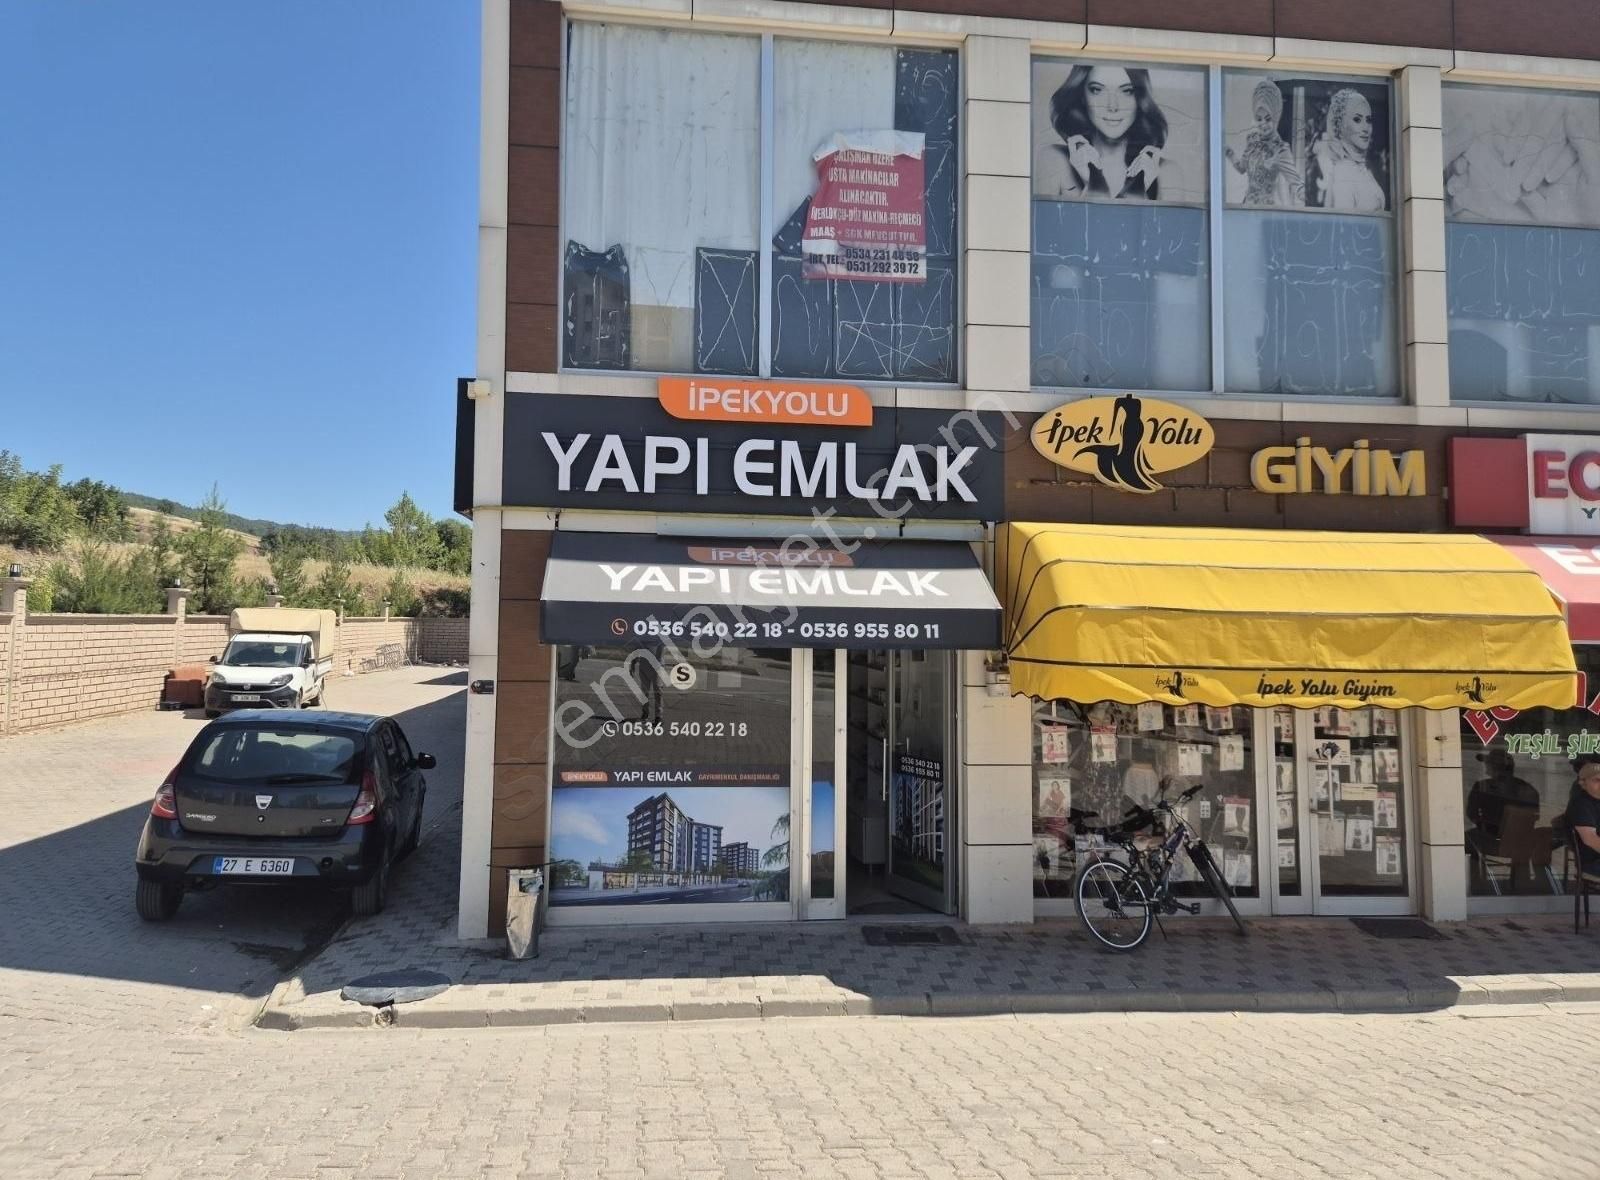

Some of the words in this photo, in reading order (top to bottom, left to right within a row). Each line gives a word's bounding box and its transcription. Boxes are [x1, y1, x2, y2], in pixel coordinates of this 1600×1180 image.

[828, 167, 848, 183] USTA
[848, 167, 900, 187] MAKİNACILAR
[810, 226, 836, 239] MAAŞ
[845, 248, 871, 259] 0534
[872, 248, 890, 260] 231
[846, 260, 870, 272] 0531
[872, 261, 891, 273] 292
[893, 262, 906, 274] 39
[907, 262, 919, 274] 72
[689, 381, 848, 417] İPEKYOLU
[1036, 412, 1104, 454] İpek
[1146, 417, 1203, 445] Yolu
[540, 431, 709, 496] YAPI
[733, 438, 979, 502] EMLAK
[1250, 436, 1426, 496] GİYİM
[597, 564, 730, 592] YAPI
[748, 570, 949, 597] EMLAK
[633, 620, 684, 637] 0536
[689, 621, 729, 638] 540
[733, 622, 758, 638] 22
[762, 622, 782, 638] 18
[800, 623, 849, 639] 0536
[853, 623, 889, 639] 955
[894, 623, 919, 639] 80
[923, 624, 940, 639] 11
[1256, 674, 1296, 698] İpek
[1300, 679, 1339, 697] Yolu
[1343, 679, 1396, 700] Giyim
[622, 721, 664, 737] 0536
[669, 722, 701, 737] 540
[704, 722, 724, 737] 22
[729, 722, 748, 737] 18
[1504, 728, 1562, 760] YEŞİL
[926, 760, 934, 769] 22
[613, 771, 643, 782] YAPI
[646, 771, 693, 782] EMLAK
[222, 859, 237, 872] 27
[245, 860, 252, 872] E
[260, 860, 290, 872] 6360
